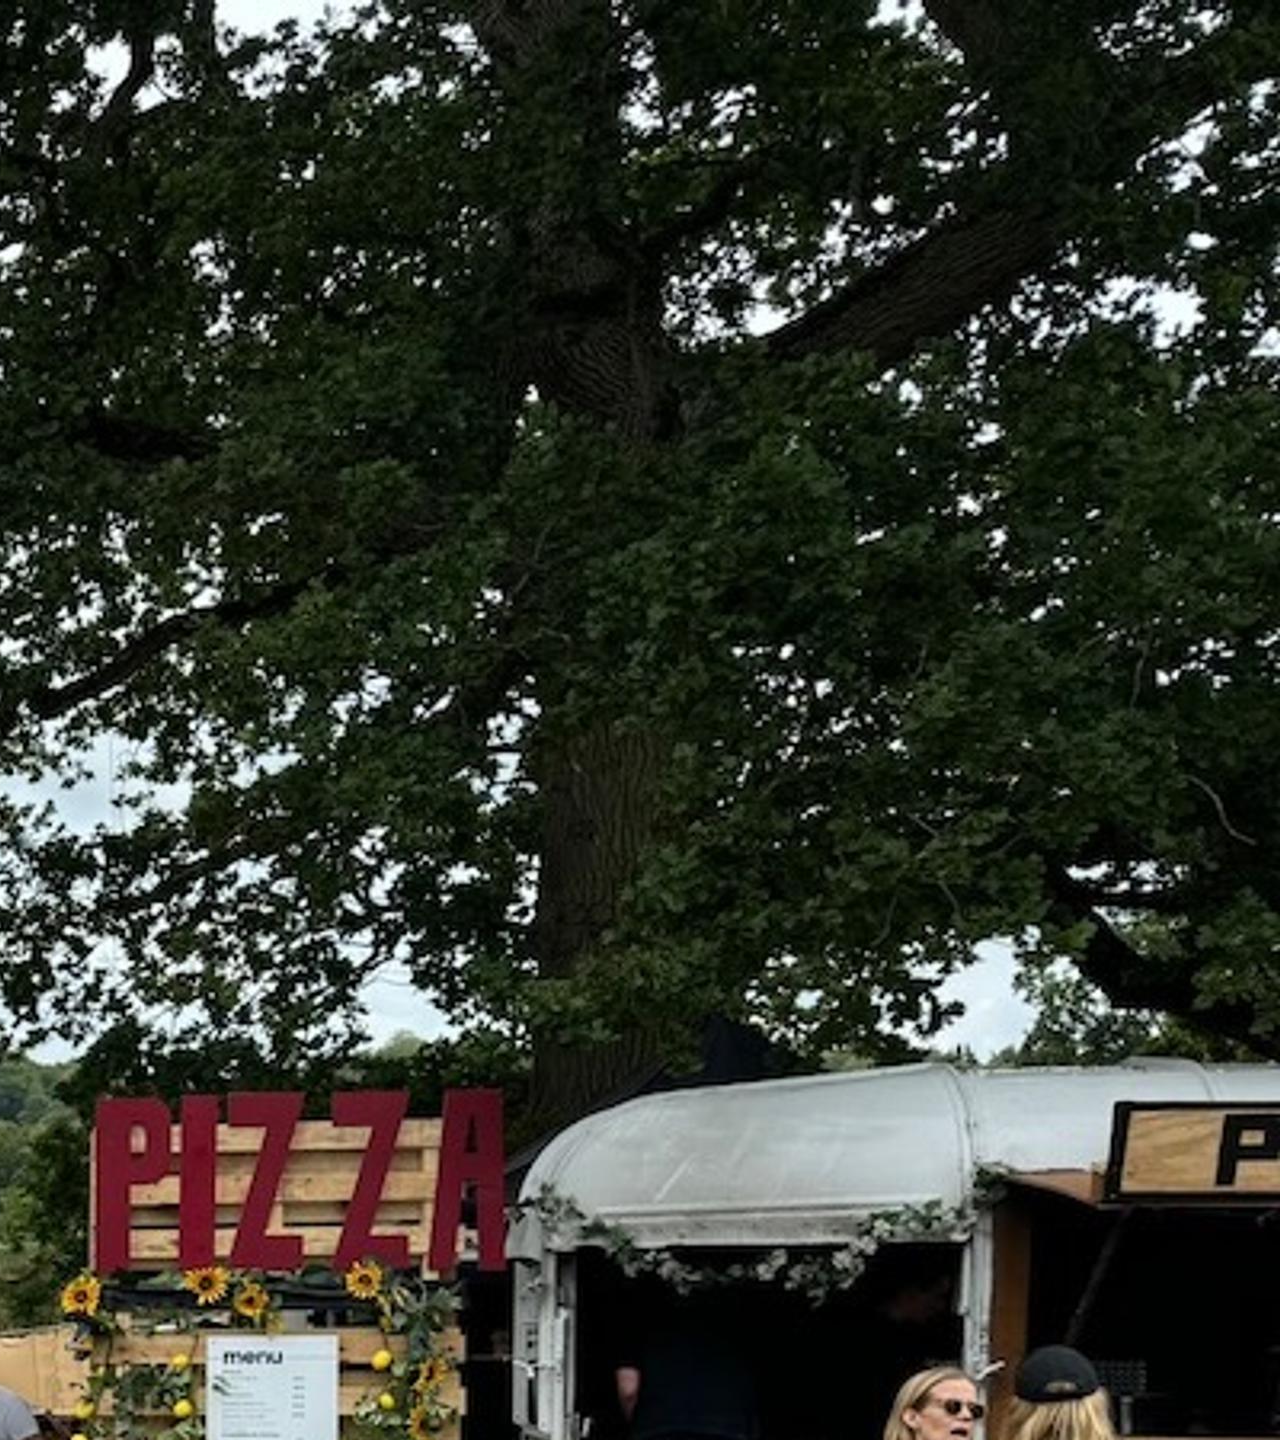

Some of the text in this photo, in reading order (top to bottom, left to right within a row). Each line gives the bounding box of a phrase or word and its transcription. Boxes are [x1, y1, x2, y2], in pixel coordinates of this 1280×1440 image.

[94, 1087, 507, 1275] PIZZA
[1216, 1114, 1280, 1185] P
[223, 1351, 283, 1365] menu
